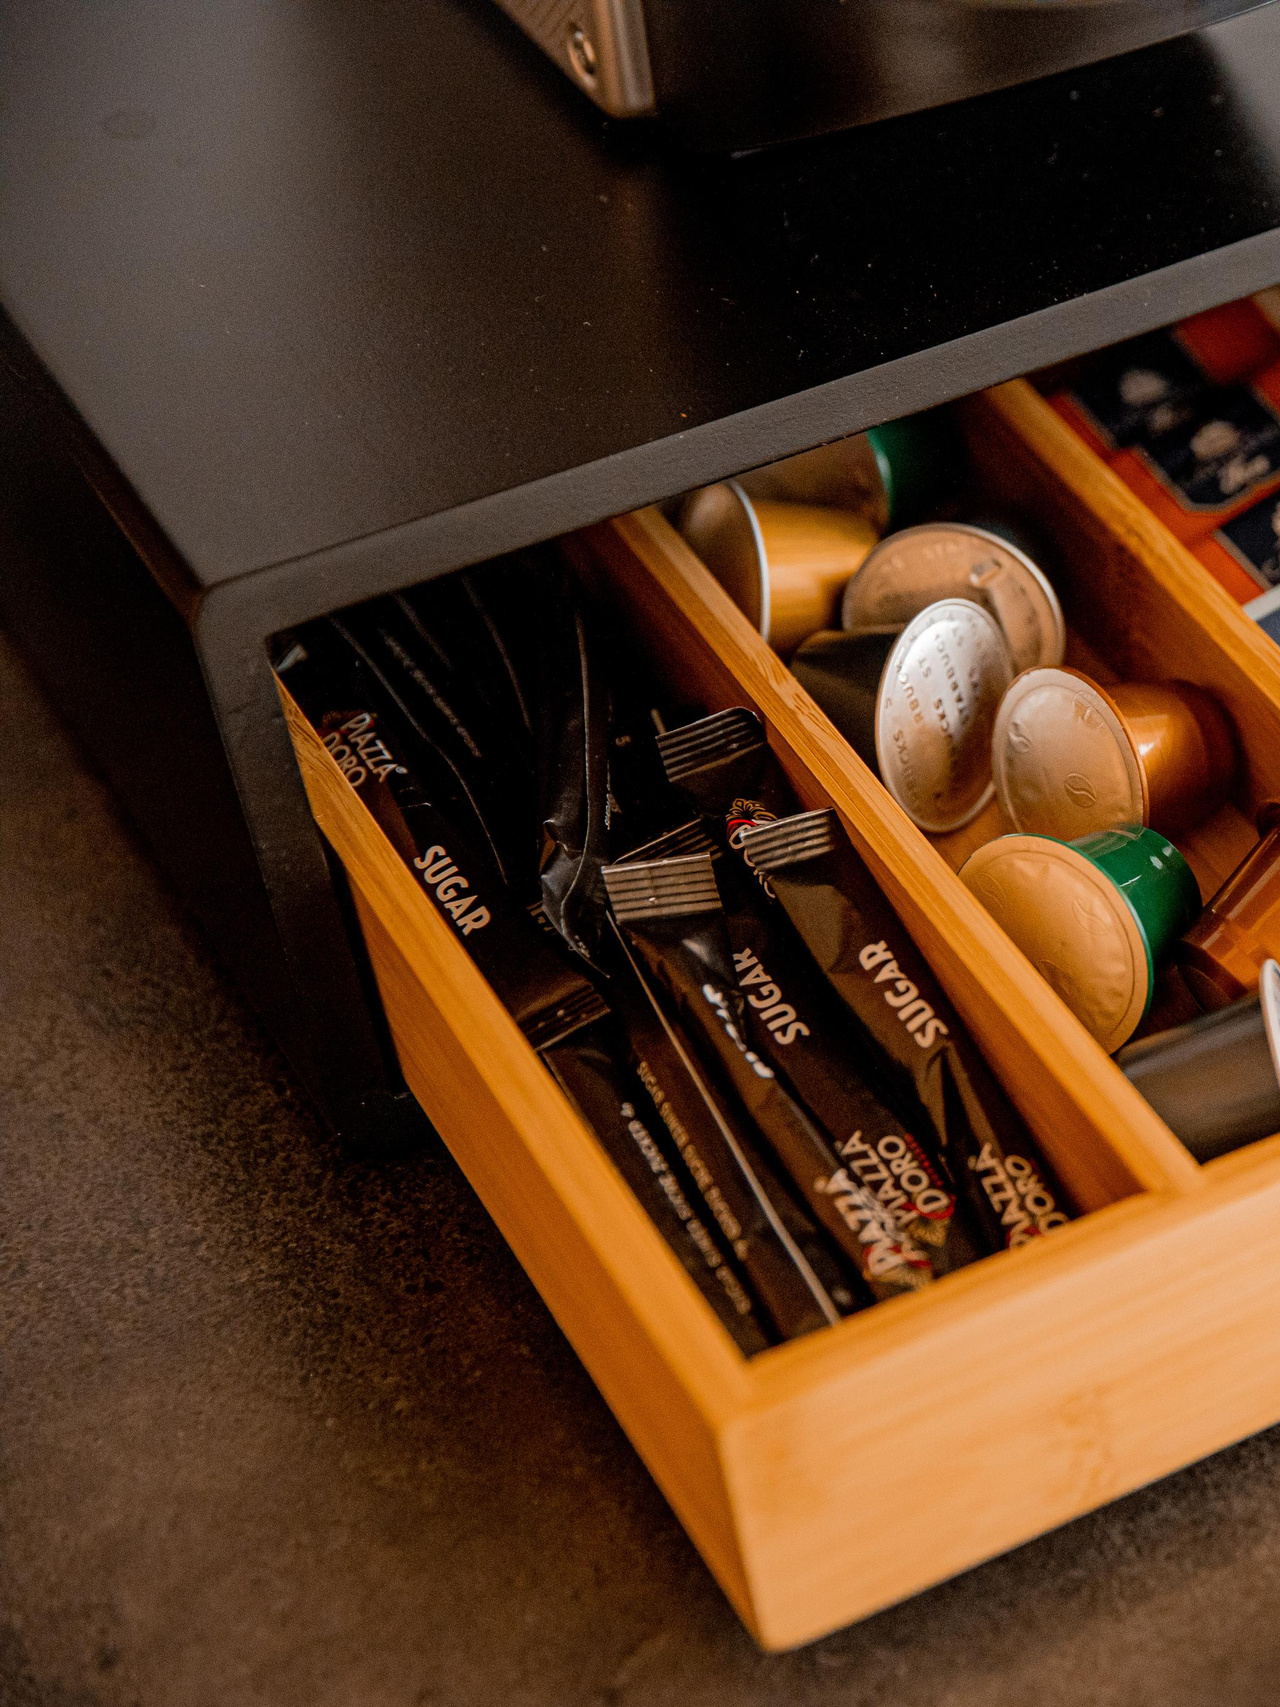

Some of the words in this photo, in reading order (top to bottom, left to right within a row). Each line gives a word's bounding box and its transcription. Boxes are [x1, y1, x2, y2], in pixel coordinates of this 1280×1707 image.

[340, 712, 399, 783] PIAZZA
[414, 845, 491, 936] SUGAR
[733, 948, 811, 1045] SUGAR
[859, 940, 949, 1049] SUGAR
[841, 1130, 919, 1229] PIAZZA
